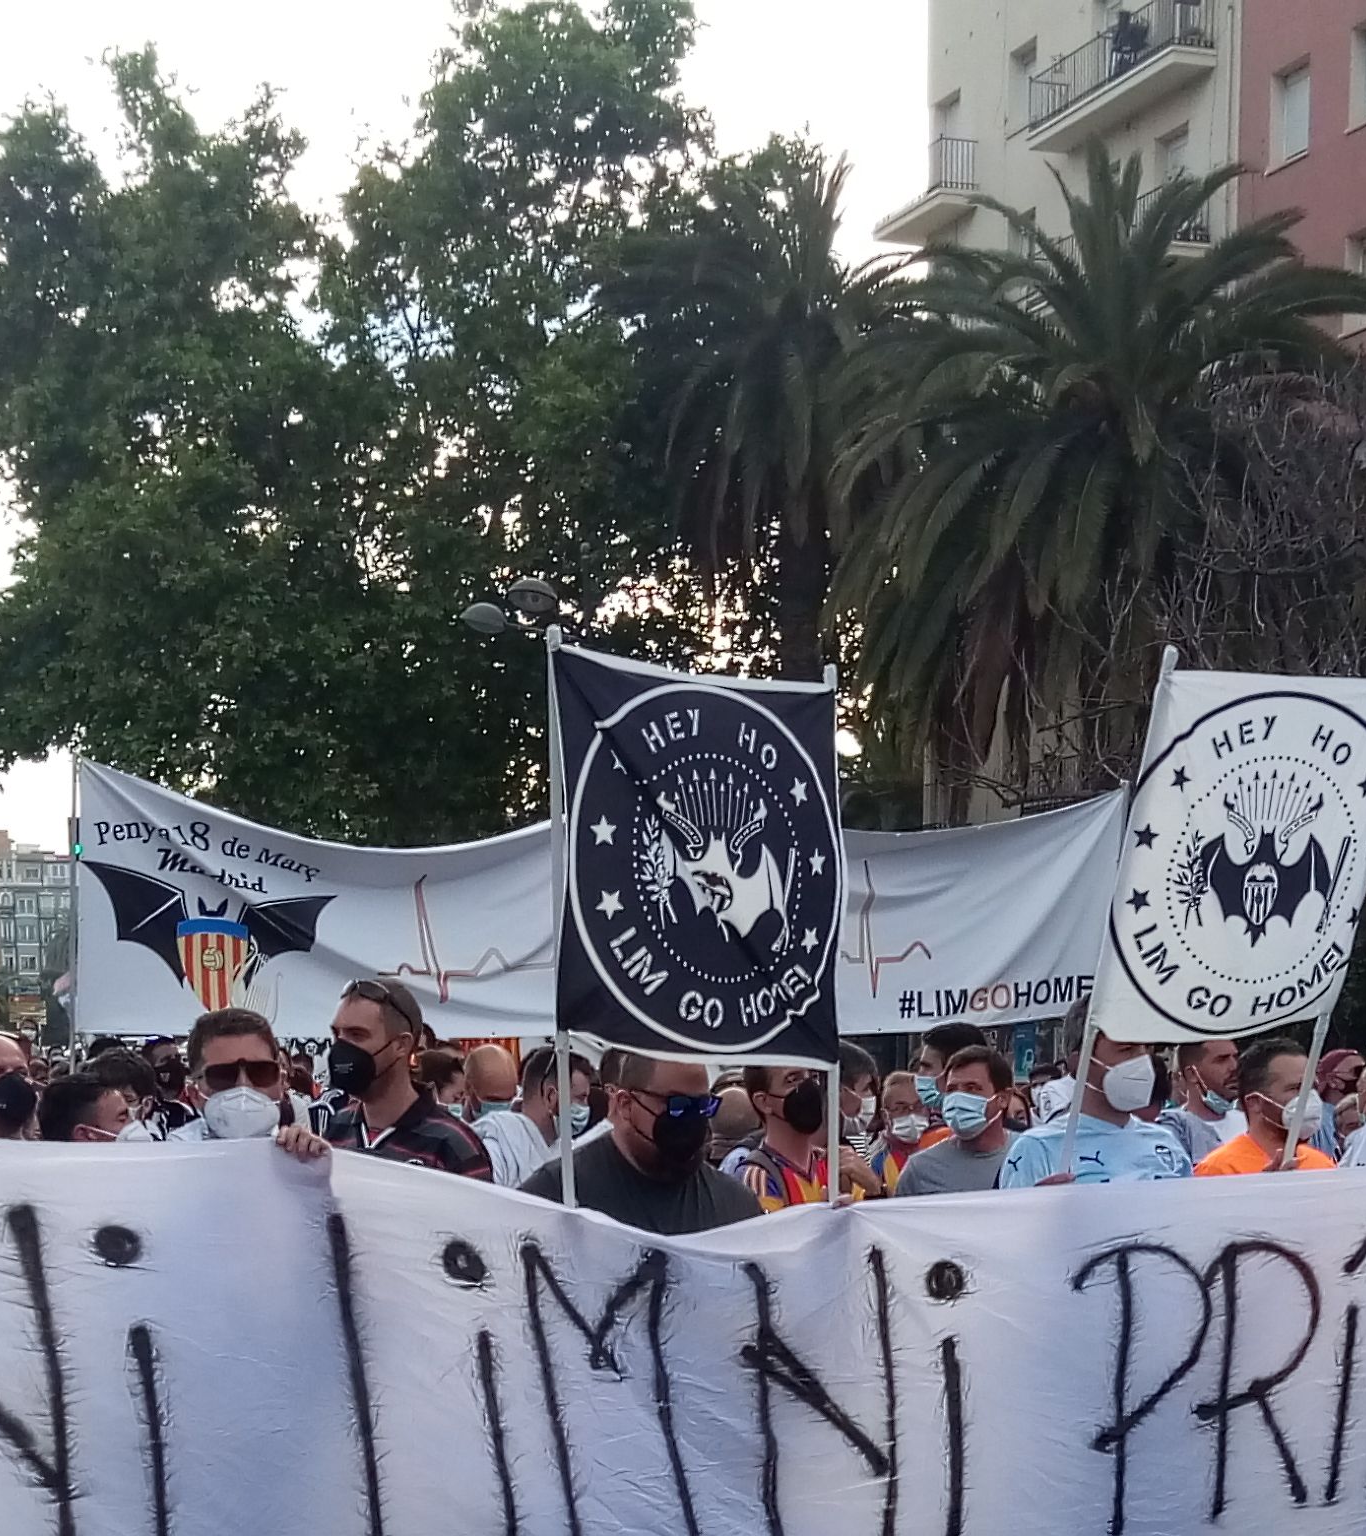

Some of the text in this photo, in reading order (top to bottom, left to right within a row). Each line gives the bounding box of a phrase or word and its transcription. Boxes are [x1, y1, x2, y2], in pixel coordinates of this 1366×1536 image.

[640, 708, 779, 771] HEY HO
[1211, 714, 1354, 765] HEY HO
[94, 821, 320, 882] Penya 18 de Març
[608, 926, 671, 996] LIM
[678, 990, 724, 1028] GO
[1132, 923, 1344, 1018] LIM GO HOME!
